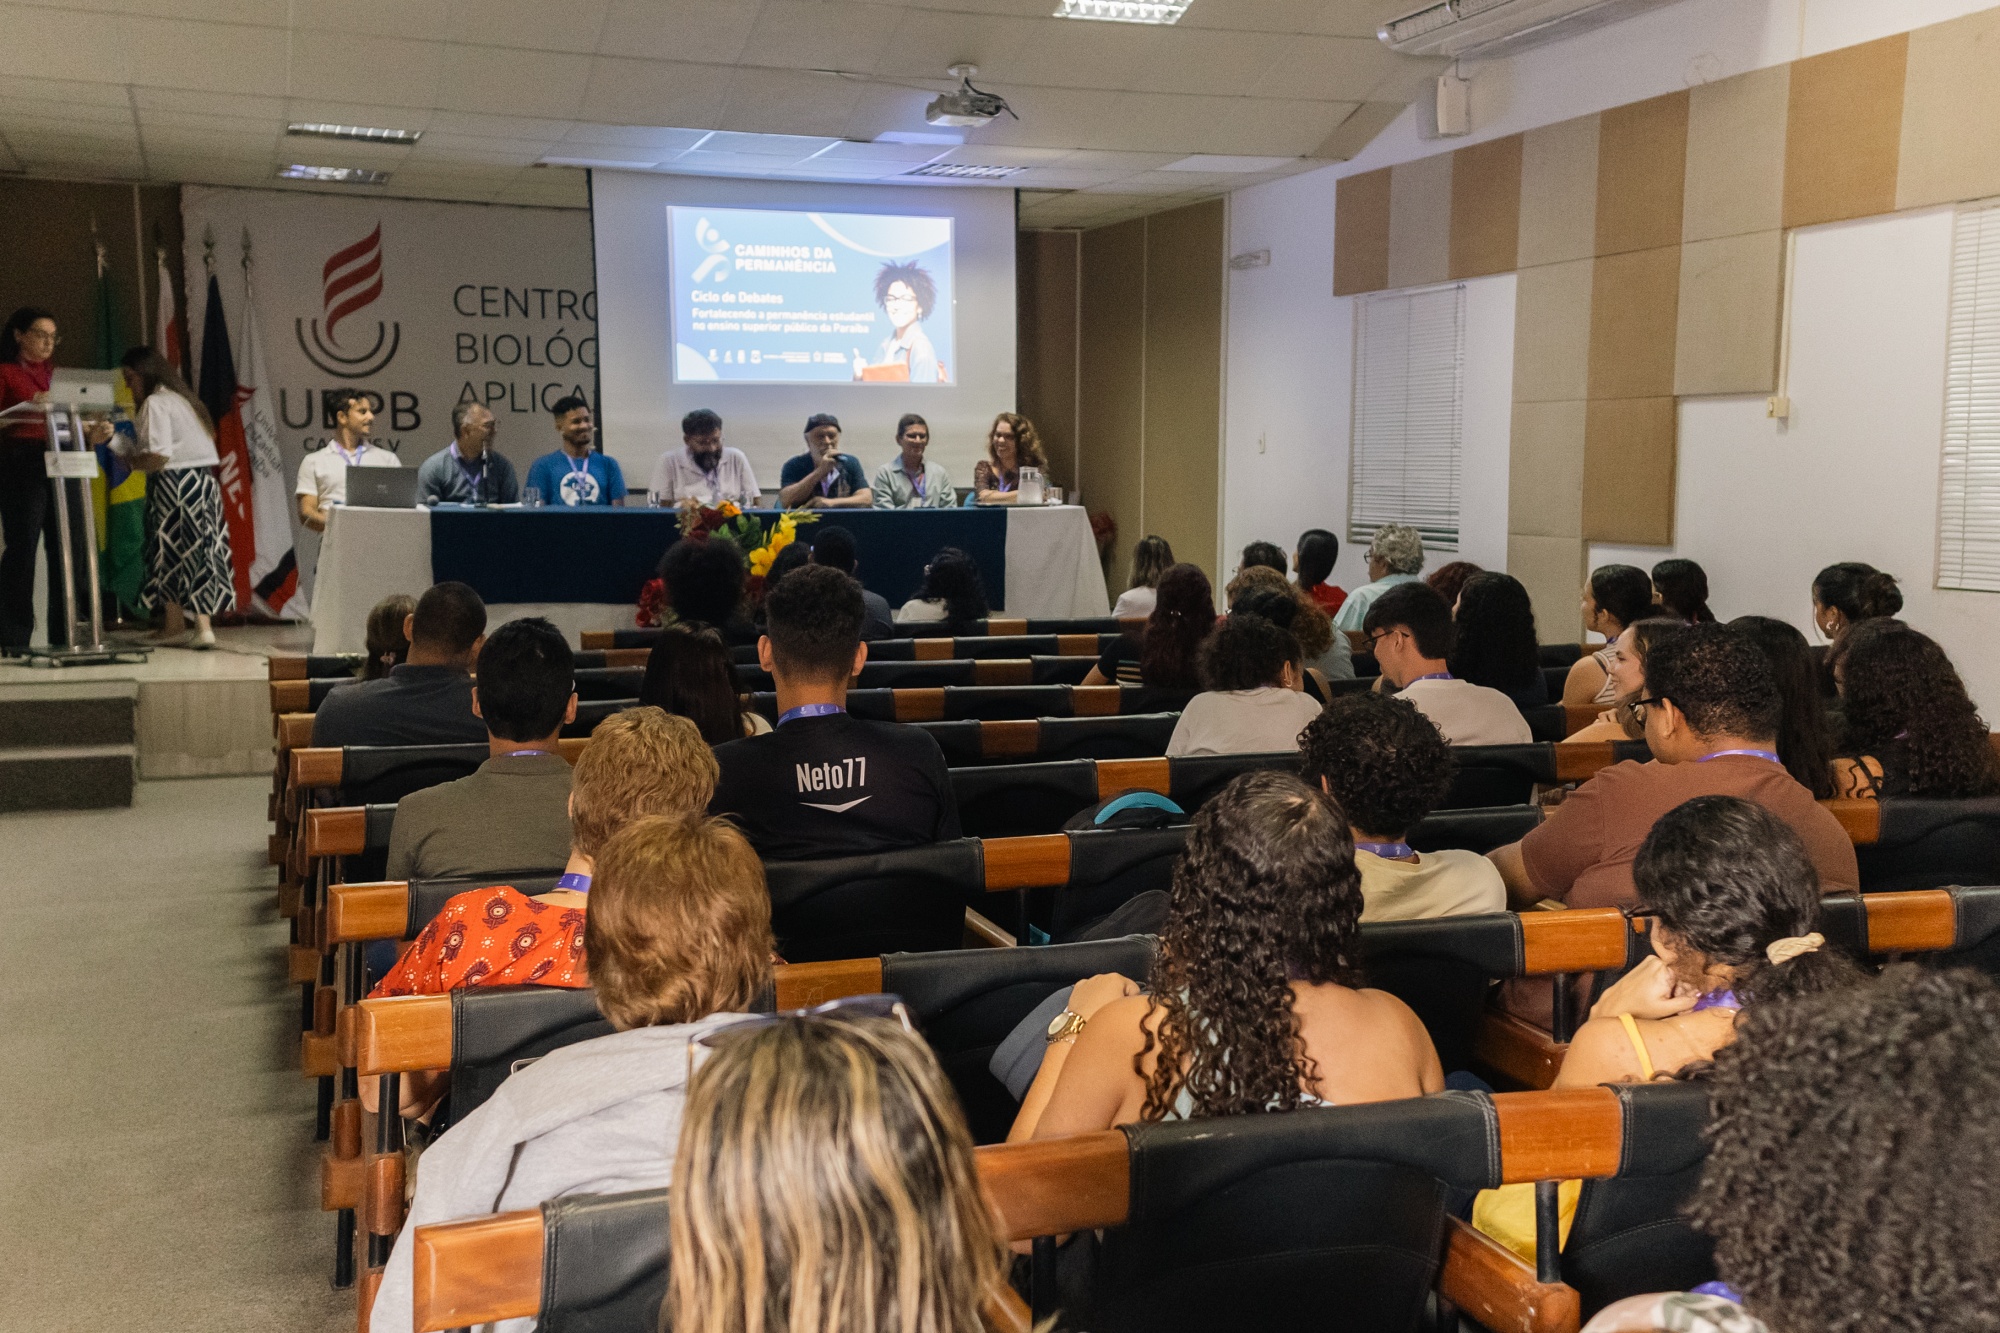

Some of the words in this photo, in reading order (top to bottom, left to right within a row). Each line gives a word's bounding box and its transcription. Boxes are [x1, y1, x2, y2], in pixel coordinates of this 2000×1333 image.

[735, 244, 810, 258] CAMINHOS
[814, 247, 833, 259] DA
[735, 258, 837, 273] PERMANÊNCIA
[691, 290, 720, 303] Ciclo
[722, 291, 736, 303] de
[738, 291, 784, 304] Debates
[692, 308, 757, 320] Fortalecendo
[758, 311, 765, 320] a
[766, 310, 828, 323] permanência
[829, 311, 876, 322] estudantil
[692, 322, 706, 331] no
[707, 321, 740, 332] ensino
[742, 322, 782, 333] superior
[784, 322, 818, 333] público
[820, 322, 831, 333] da
[833, 322, 870, 333] Paraíba
[796, 756, 866, 793] Neto77
